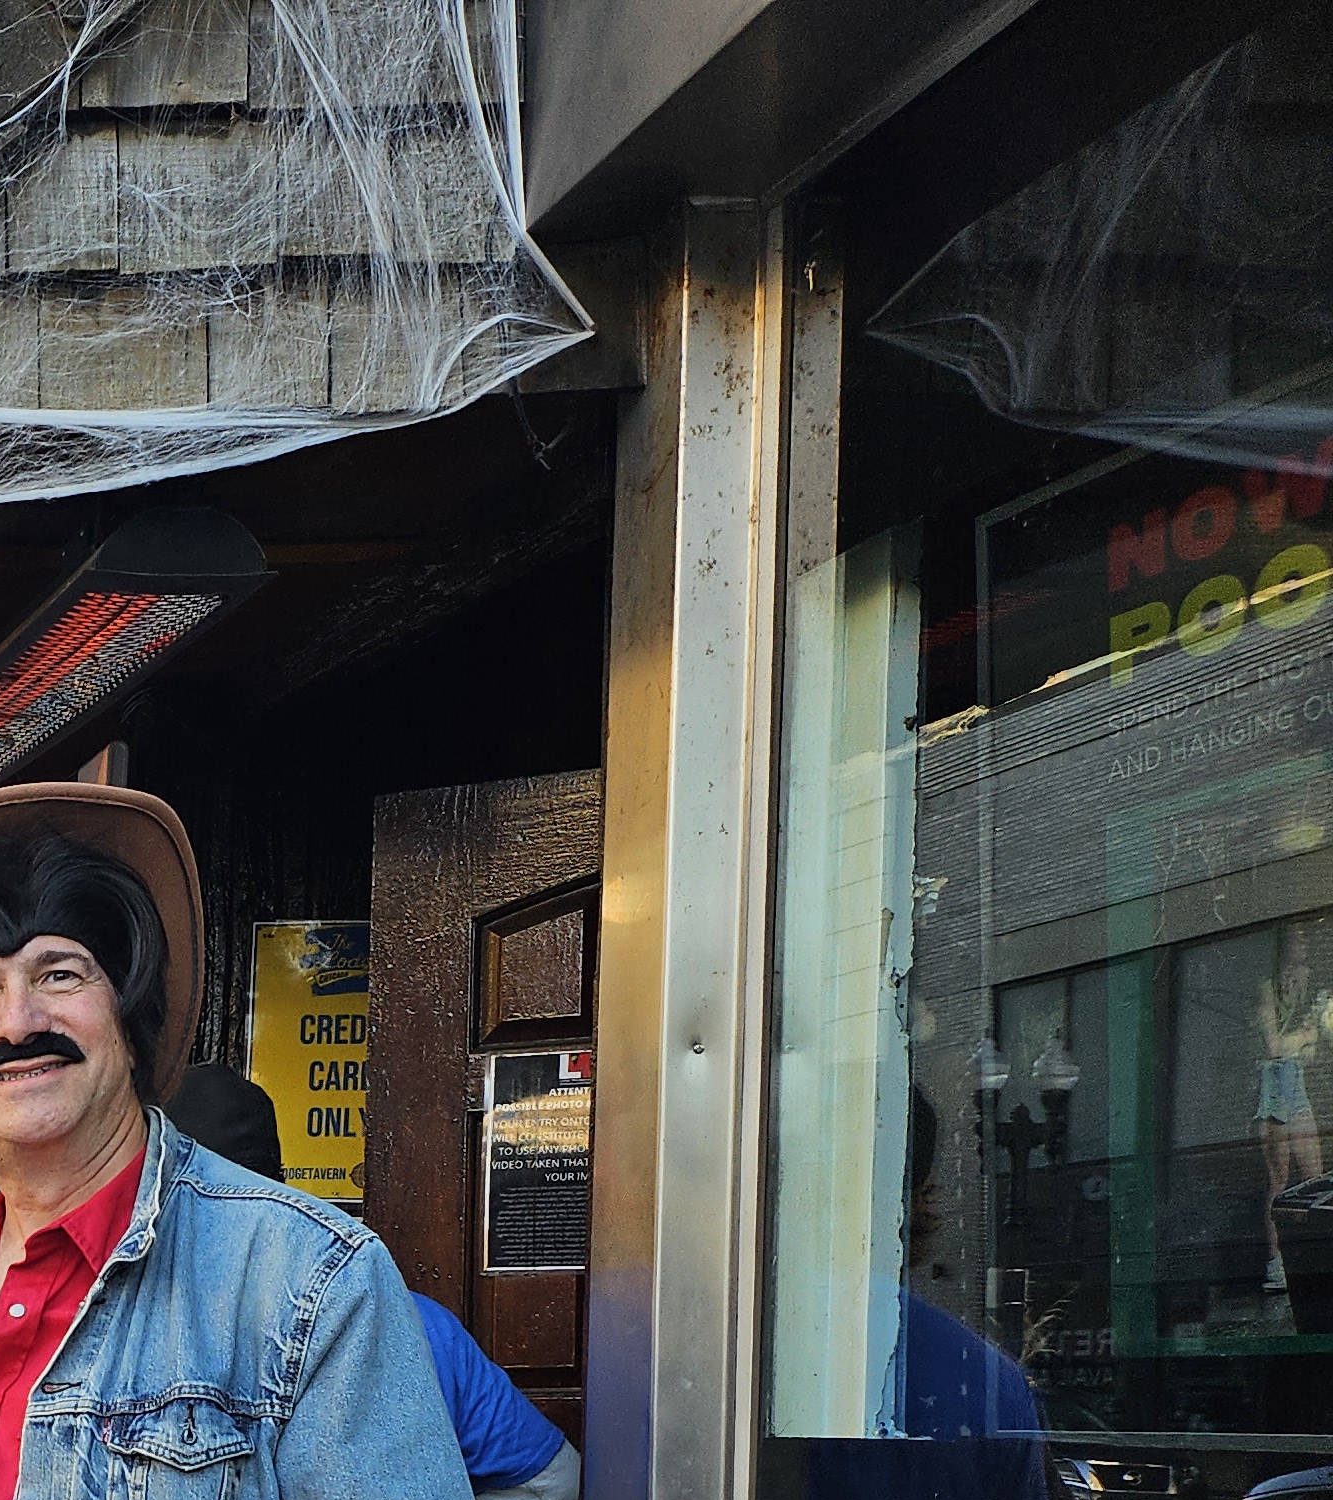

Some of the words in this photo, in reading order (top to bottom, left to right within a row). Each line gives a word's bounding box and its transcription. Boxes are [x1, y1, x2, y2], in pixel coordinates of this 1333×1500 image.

[1108, 433, 1333, 592] NOW
[1108, 745, 1161, 783] AND
[1170, 704, 1295, 764] HANGING
[300, 1014, 367, 1045] CRED
[548, 1086, 591, 1097] ATTENT
[494, 1102, 544, 1113] POSSIBLE
[545, 1099, 584, 1110] PHOTO
[492, 1120, 523, 1130] YOUR
[491, 1132, 516, 1144] WILL
[498, 1146, 513, 1157] TO
[515, 1145, 536, 1156] USE
[537, 1144, 560, 1155] ANY
[561, 1143, 589, 1154] PHO
[491, 1160, 524, 1170] VIDEO
[526, 1158, 560, 1169] TAKEN
[562, 1157, 589, 1168] THAT
[544, 1172, 575, 1182] YOUR
